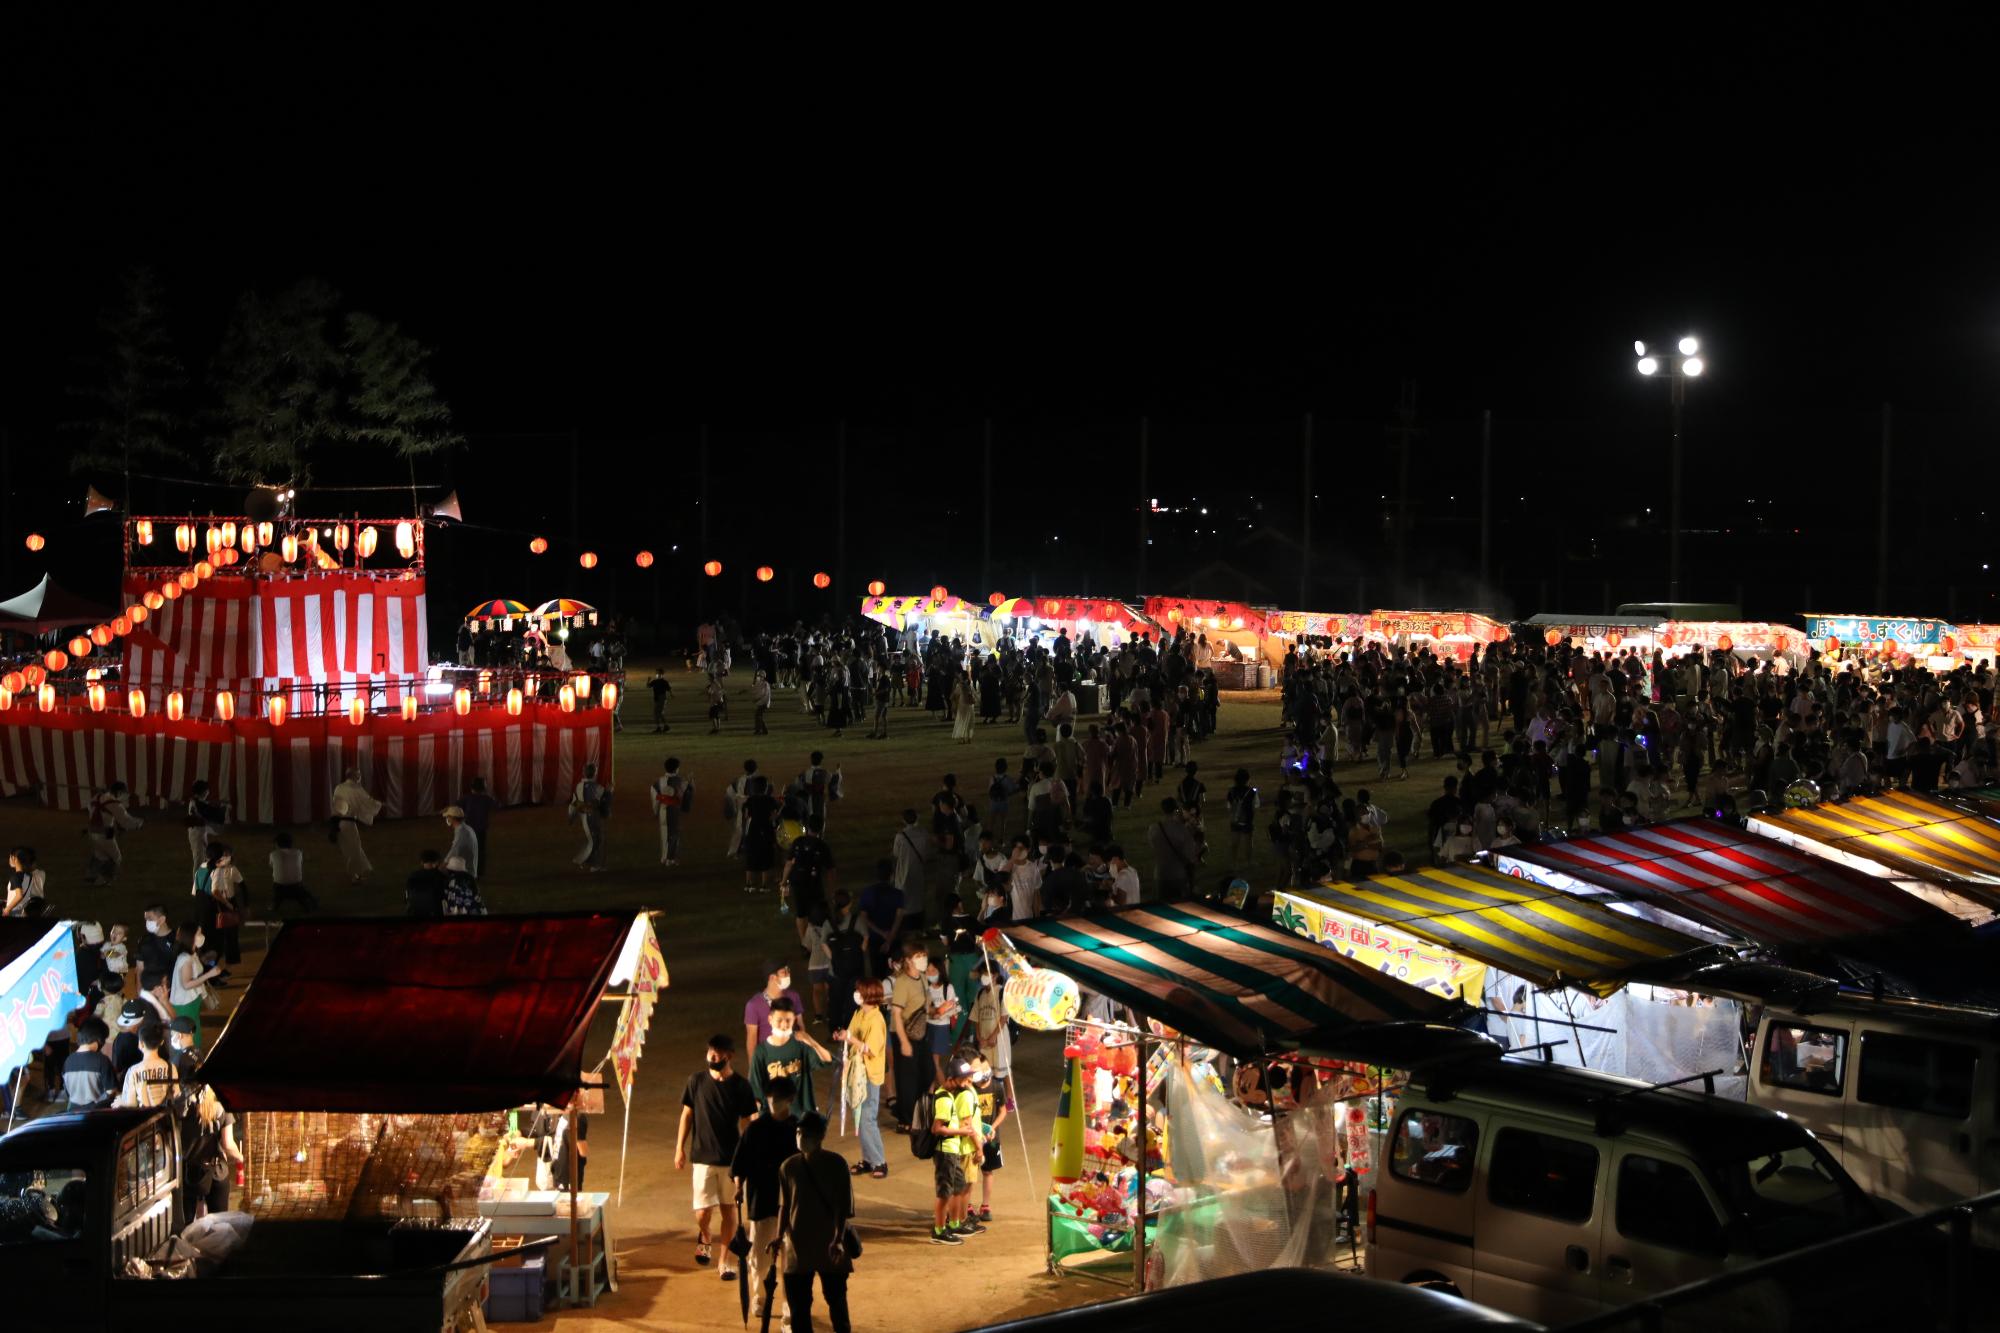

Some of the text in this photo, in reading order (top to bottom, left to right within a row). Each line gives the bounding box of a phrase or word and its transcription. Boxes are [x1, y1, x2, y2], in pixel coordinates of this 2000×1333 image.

[874, 599, 945, 610] やきそば
[1324, 917, 1464, 975] 南国スイーツ
[134, 1067, 169, 1083] NOTABL
